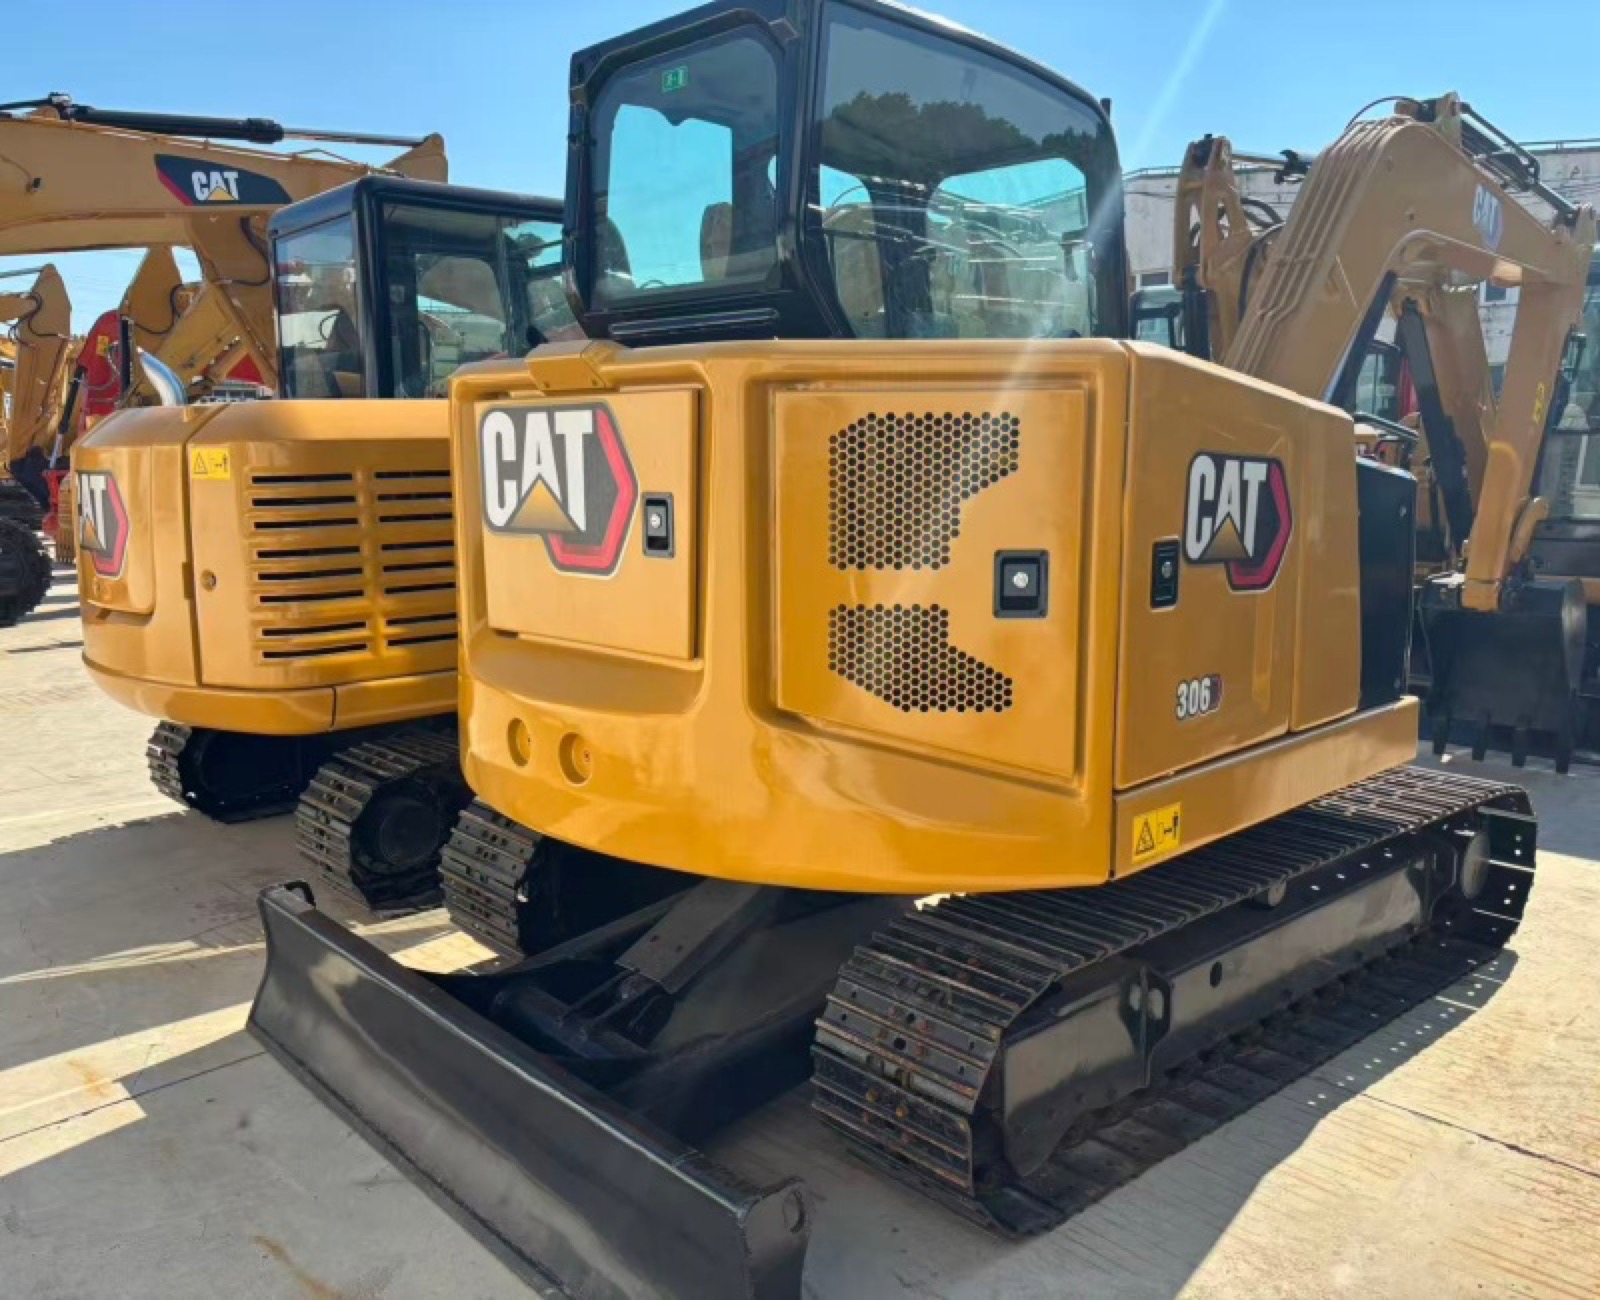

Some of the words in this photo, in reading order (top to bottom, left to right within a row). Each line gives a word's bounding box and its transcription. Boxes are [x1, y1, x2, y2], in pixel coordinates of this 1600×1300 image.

[191, 170, 239, 201] CAT
[483, 410, 593, 532] CAT
[1185, 454, 1268, 561] CAT
[76, 474, 106, 551] AT
[1177, 677, 1211, 718] 306
